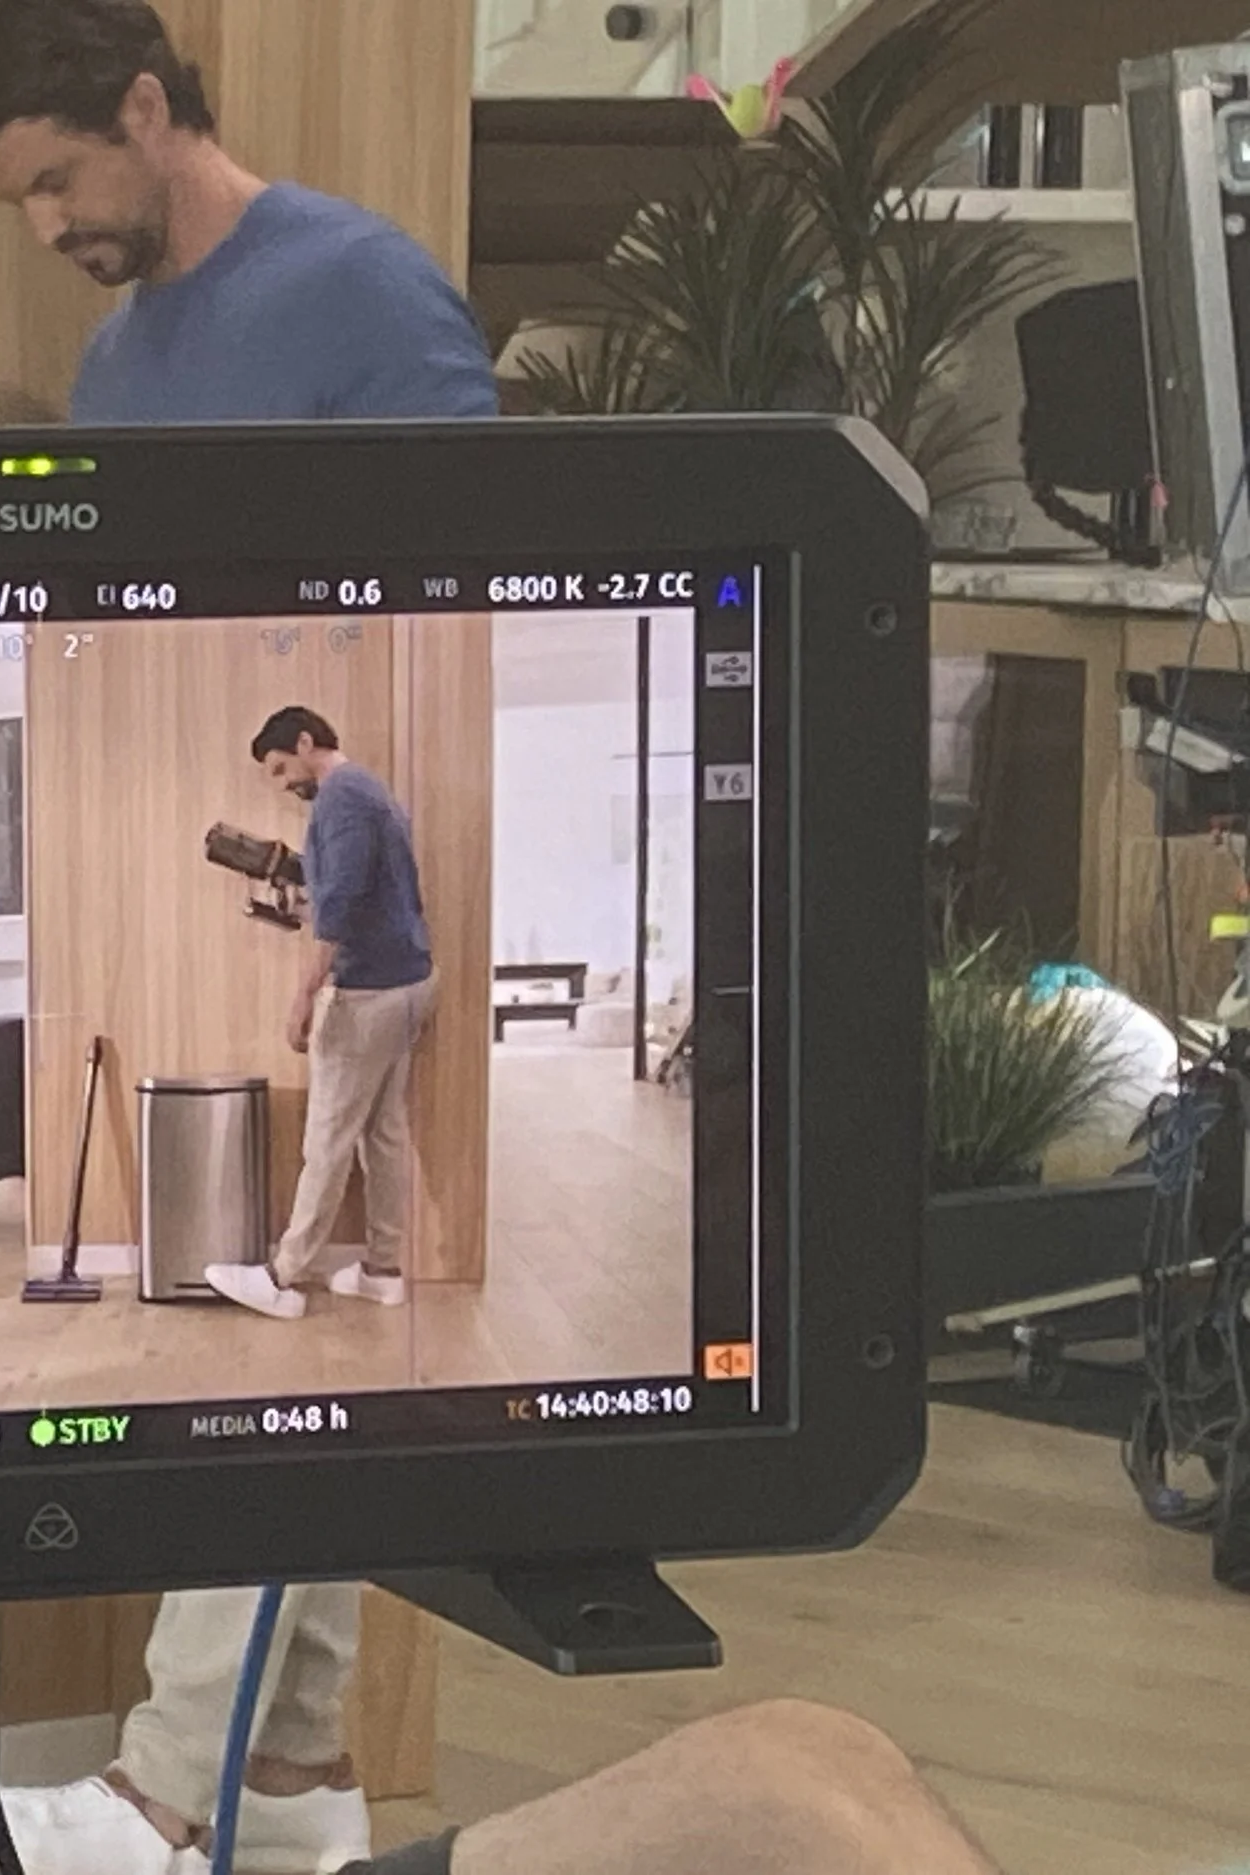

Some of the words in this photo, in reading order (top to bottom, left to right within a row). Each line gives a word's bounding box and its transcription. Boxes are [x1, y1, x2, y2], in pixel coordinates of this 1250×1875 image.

[0, 502, 99, 532] SUMO
[121, 583, 177, 611] 640
[299, 580, 329, 601] ND
[338, 578, 382, 606] 0.6
[423, 578, 459, 599] WB
[487, 575, 558, 602] 6800
[564, 574, 584, 601] K
[596, 573, 649, 601] -2.7
[657, 572, 695, 599] CC
[717, 574, 742, 608] A
[506, 1400, 532, 1422] TC
[535, 1386, 693, 1420] 14:40:48:10
[58, 1415, 130, 1445] STBY
[190, 1414, 257, 1439] MEDIA
[261, 1404, 323, 1434] 0:48
[329, 1401, 348, 1430] h
